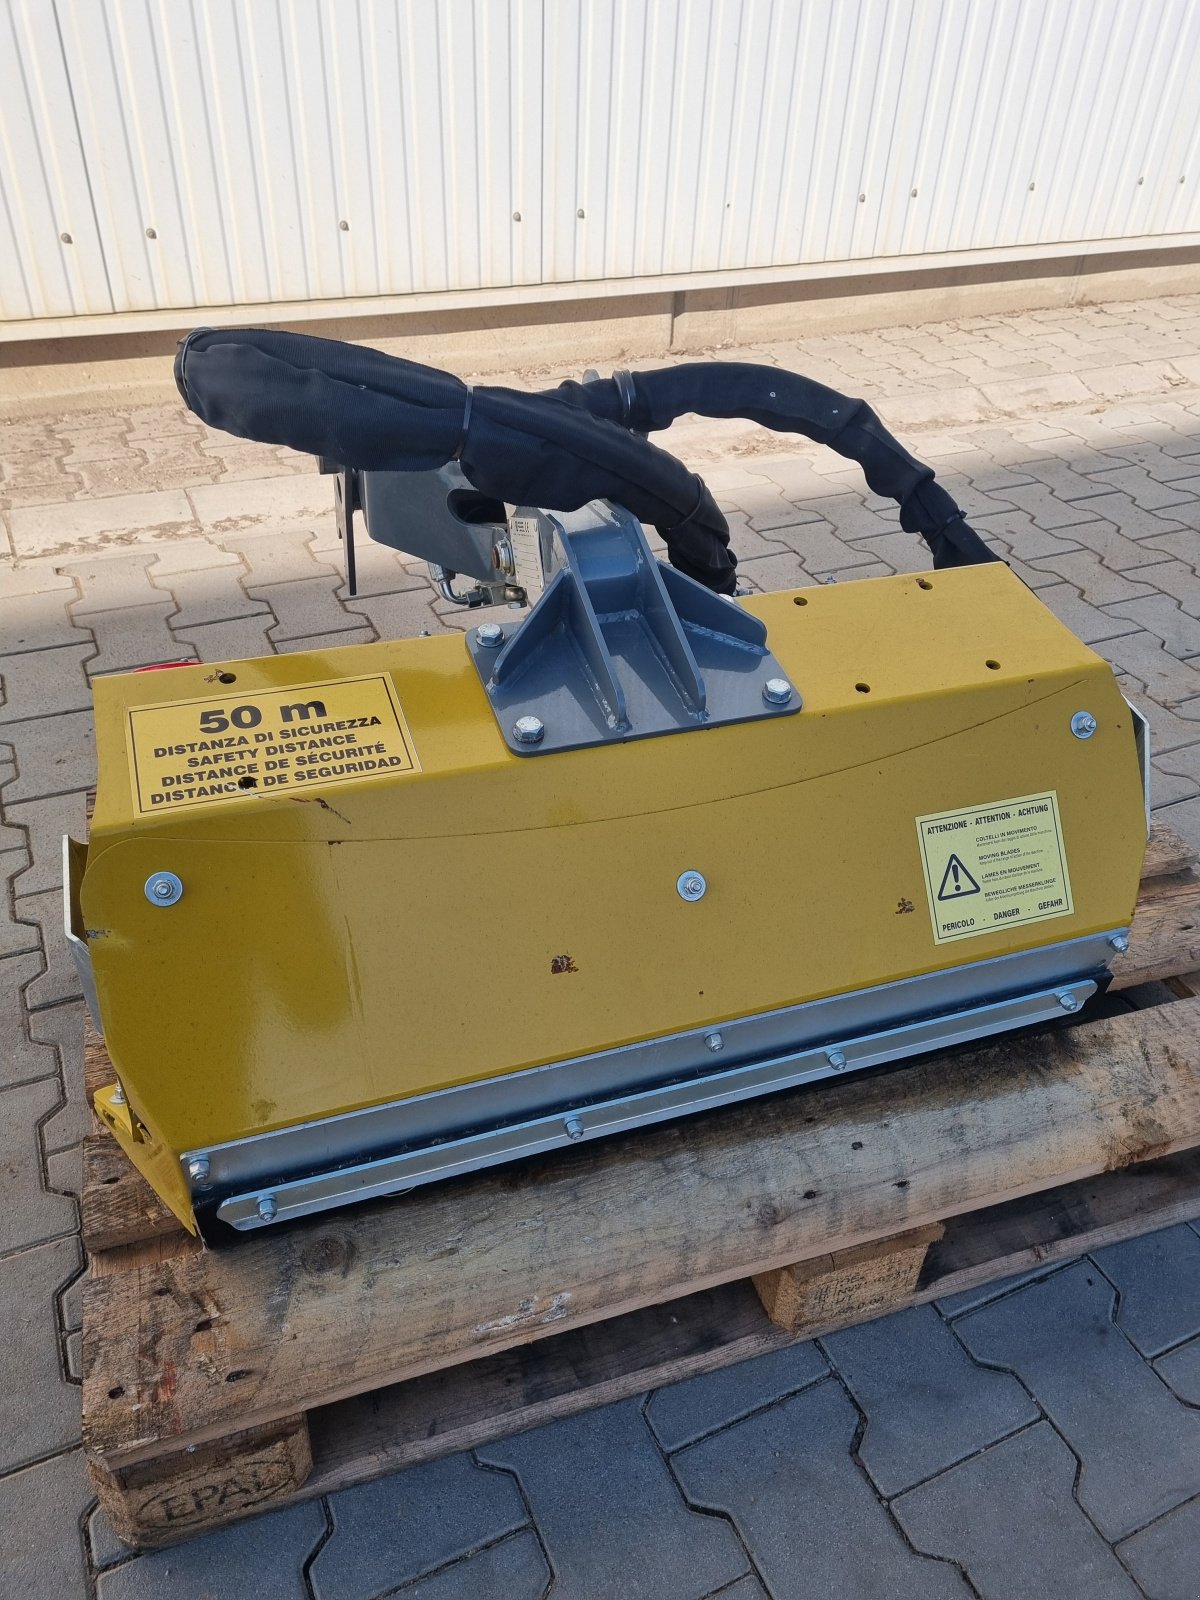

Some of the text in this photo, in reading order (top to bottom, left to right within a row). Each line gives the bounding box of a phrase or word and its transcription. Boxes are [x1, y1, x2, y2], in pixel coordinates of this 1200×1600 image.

[199, 701, 327, 734] 50 m
[153, 716, 381, 758] DISTANZA DI SICUREZZA
[187, 734, 357, 768] SAFETY DISTANCE
[161, 741, 387, 787] DISTANCE DE SÉCURITÉ
[263, 775, 289, 787] DE
[294, 756, 402, 781] SEGURIDAD
[927, 820, 968, 835] ATTENZIONE
[975, 812, 1011, 826] ATTENTION
[1018, 804, 1049, 817] ACHTUNG
[976, 834, 999, 842] COLTELLI
[1007, 826, 1037, 836] MOVIMENTO
[979, 852, 999, 860] MOVING
[1008, 863, 1040, 873] MOUVEMENT
[985, 886, 1017, 897] BEWEGLICHE
[942, 918, 975, 932] PERICOLO
[994, 908, 1020, 921] DANGER
[1038, 898, 1063, 910] GEFAHR
[161, 1469, 280, 1521] EPAL
